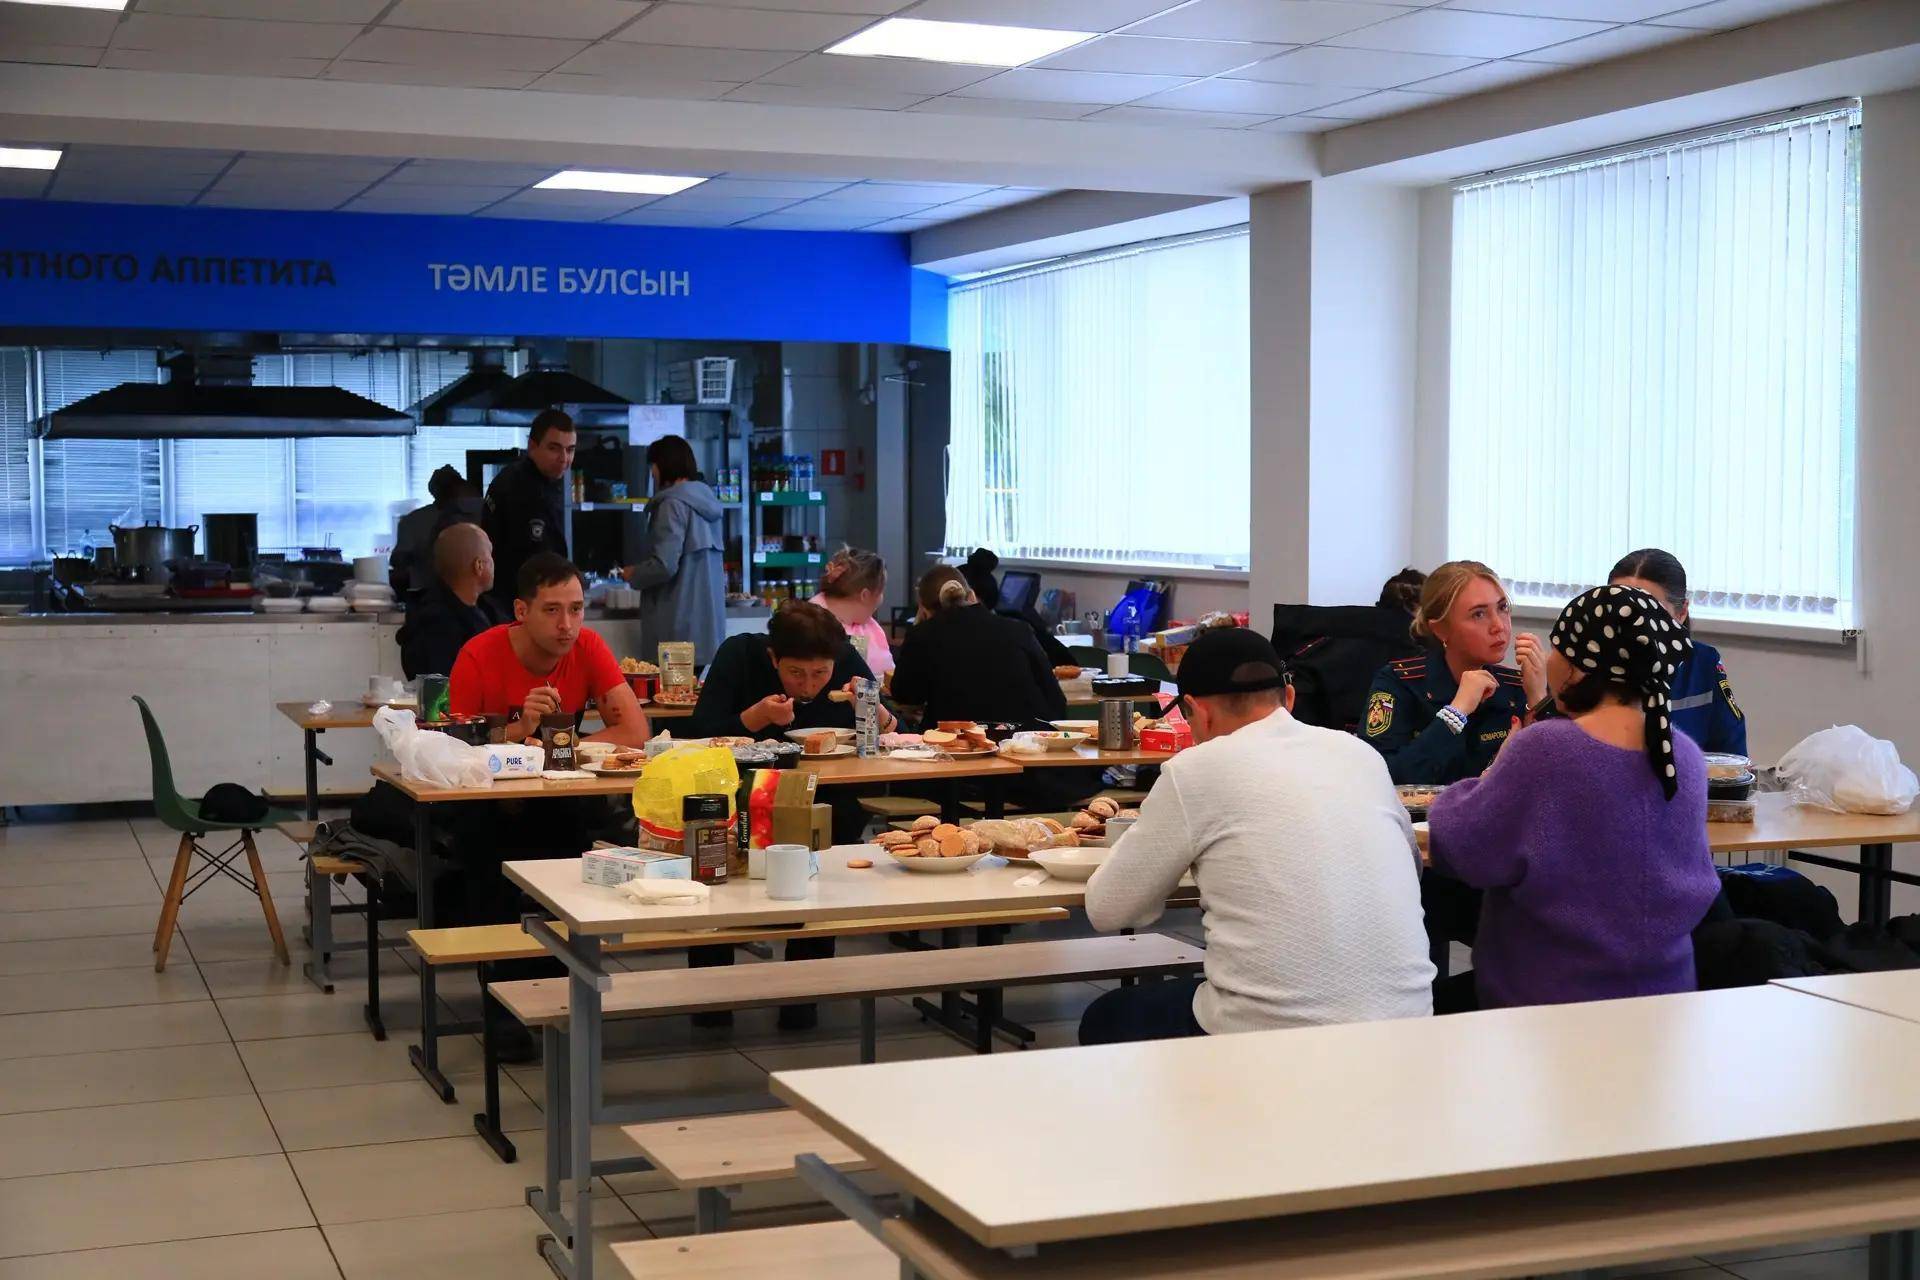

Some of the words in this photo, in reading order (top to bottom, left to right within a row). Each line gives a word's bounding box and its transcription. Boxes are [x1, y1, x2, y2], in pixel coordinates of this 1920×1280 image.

[152, 255, 336, 287] АППЕТИТА
[428, 263, 548, 293] ТӘМЛЕ
[558, 267, 690, 297] БУЛСЫН
[506, 757, 523, 766] PURE
